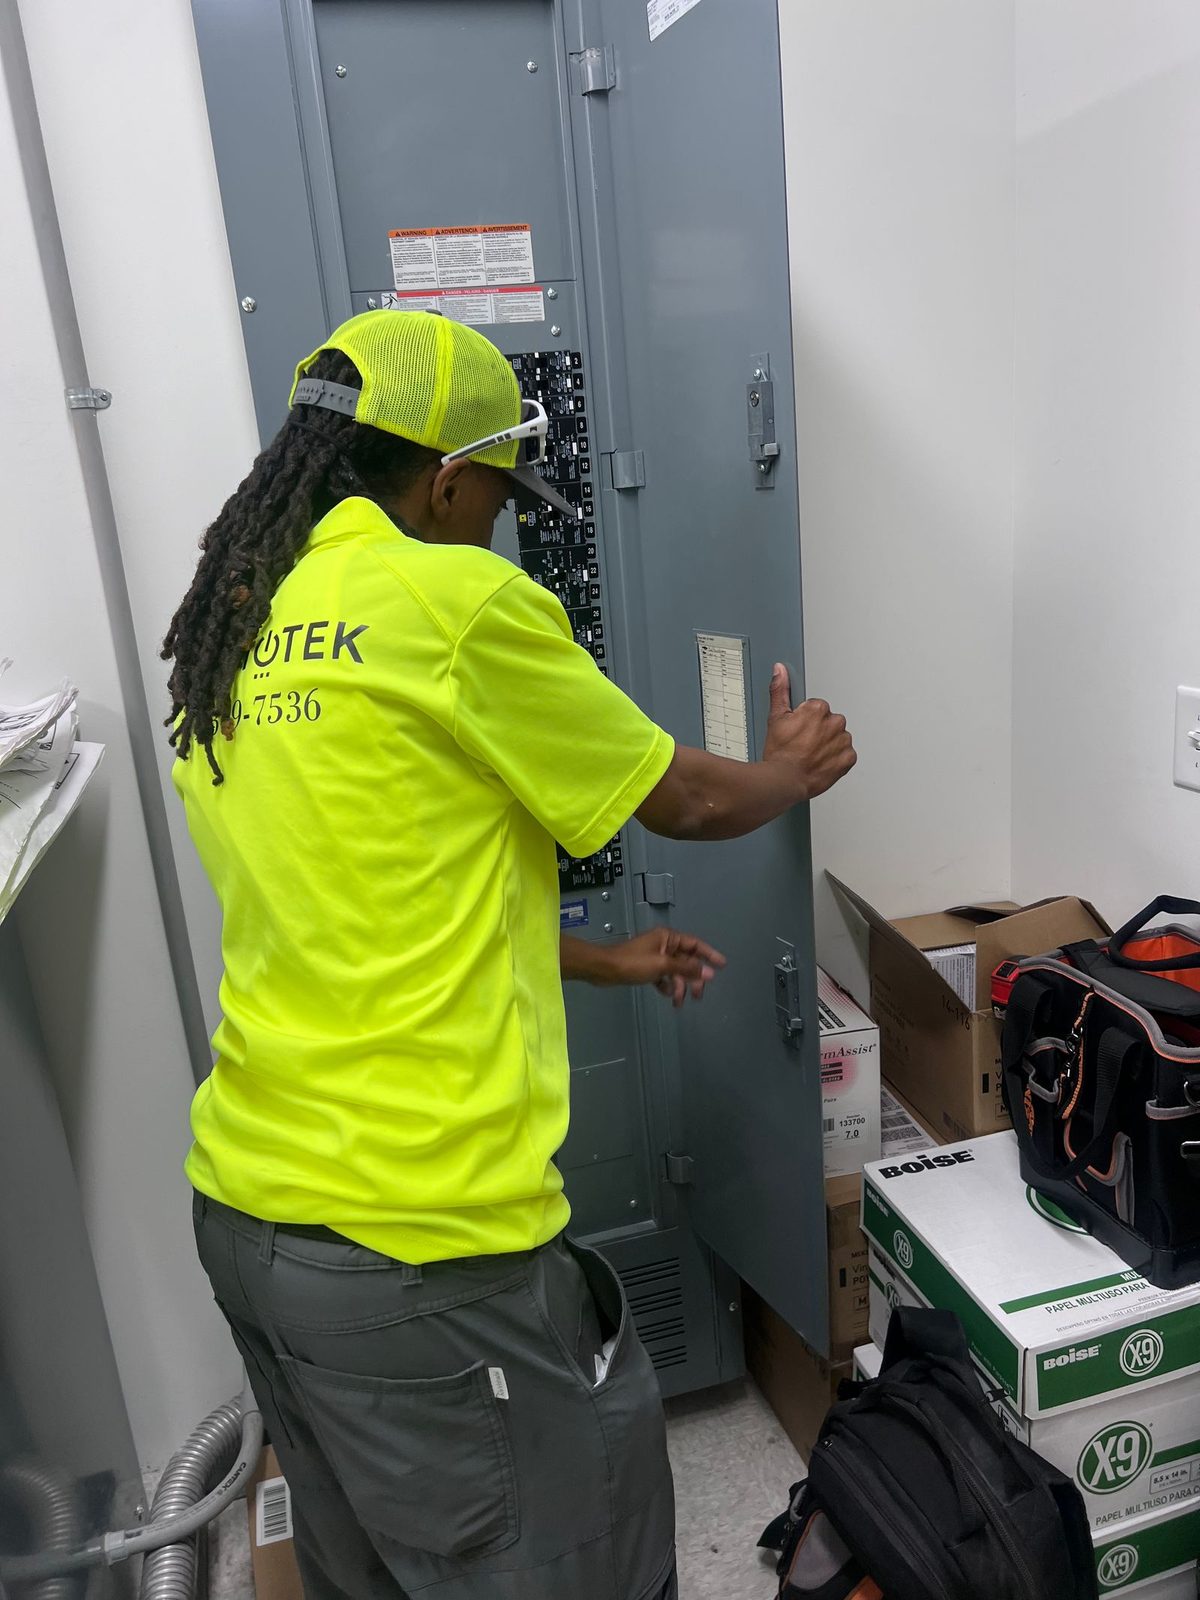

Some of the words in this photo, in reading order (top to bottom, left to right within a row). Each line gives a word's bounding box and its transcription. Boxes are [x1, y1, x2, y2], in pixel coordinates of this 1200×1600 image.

[400, 229, 427, 237] WARNING
[440, 227, 478, 235] ADVERTENCIA
[582, 462, 588, 470] 12
[212, 687, 322, 737] 9-7536
[820, 1044, 874, 1059] mAssist
[839, 1117, 866, 1127] 133700
[845, 1129, 859, 1139] 7.0
[1119, 1271, 1142, 1282] MUL
[1045, 1301, 1078, 1314] PAPEL
[1077, 1289, 1123, 1307] MULTIUSO
[1122, 1281, 1150, 1295] PARA
[1089, 1430, 1141, 1487] X-9
[1095, 1511, 1123, 1526] PAPEL
[1125, 1498, 1168, 1517] MULTIUSO
[1169, 1487, 1192, 1502] PARA
[1193, 1485, 1200, 1494] C
